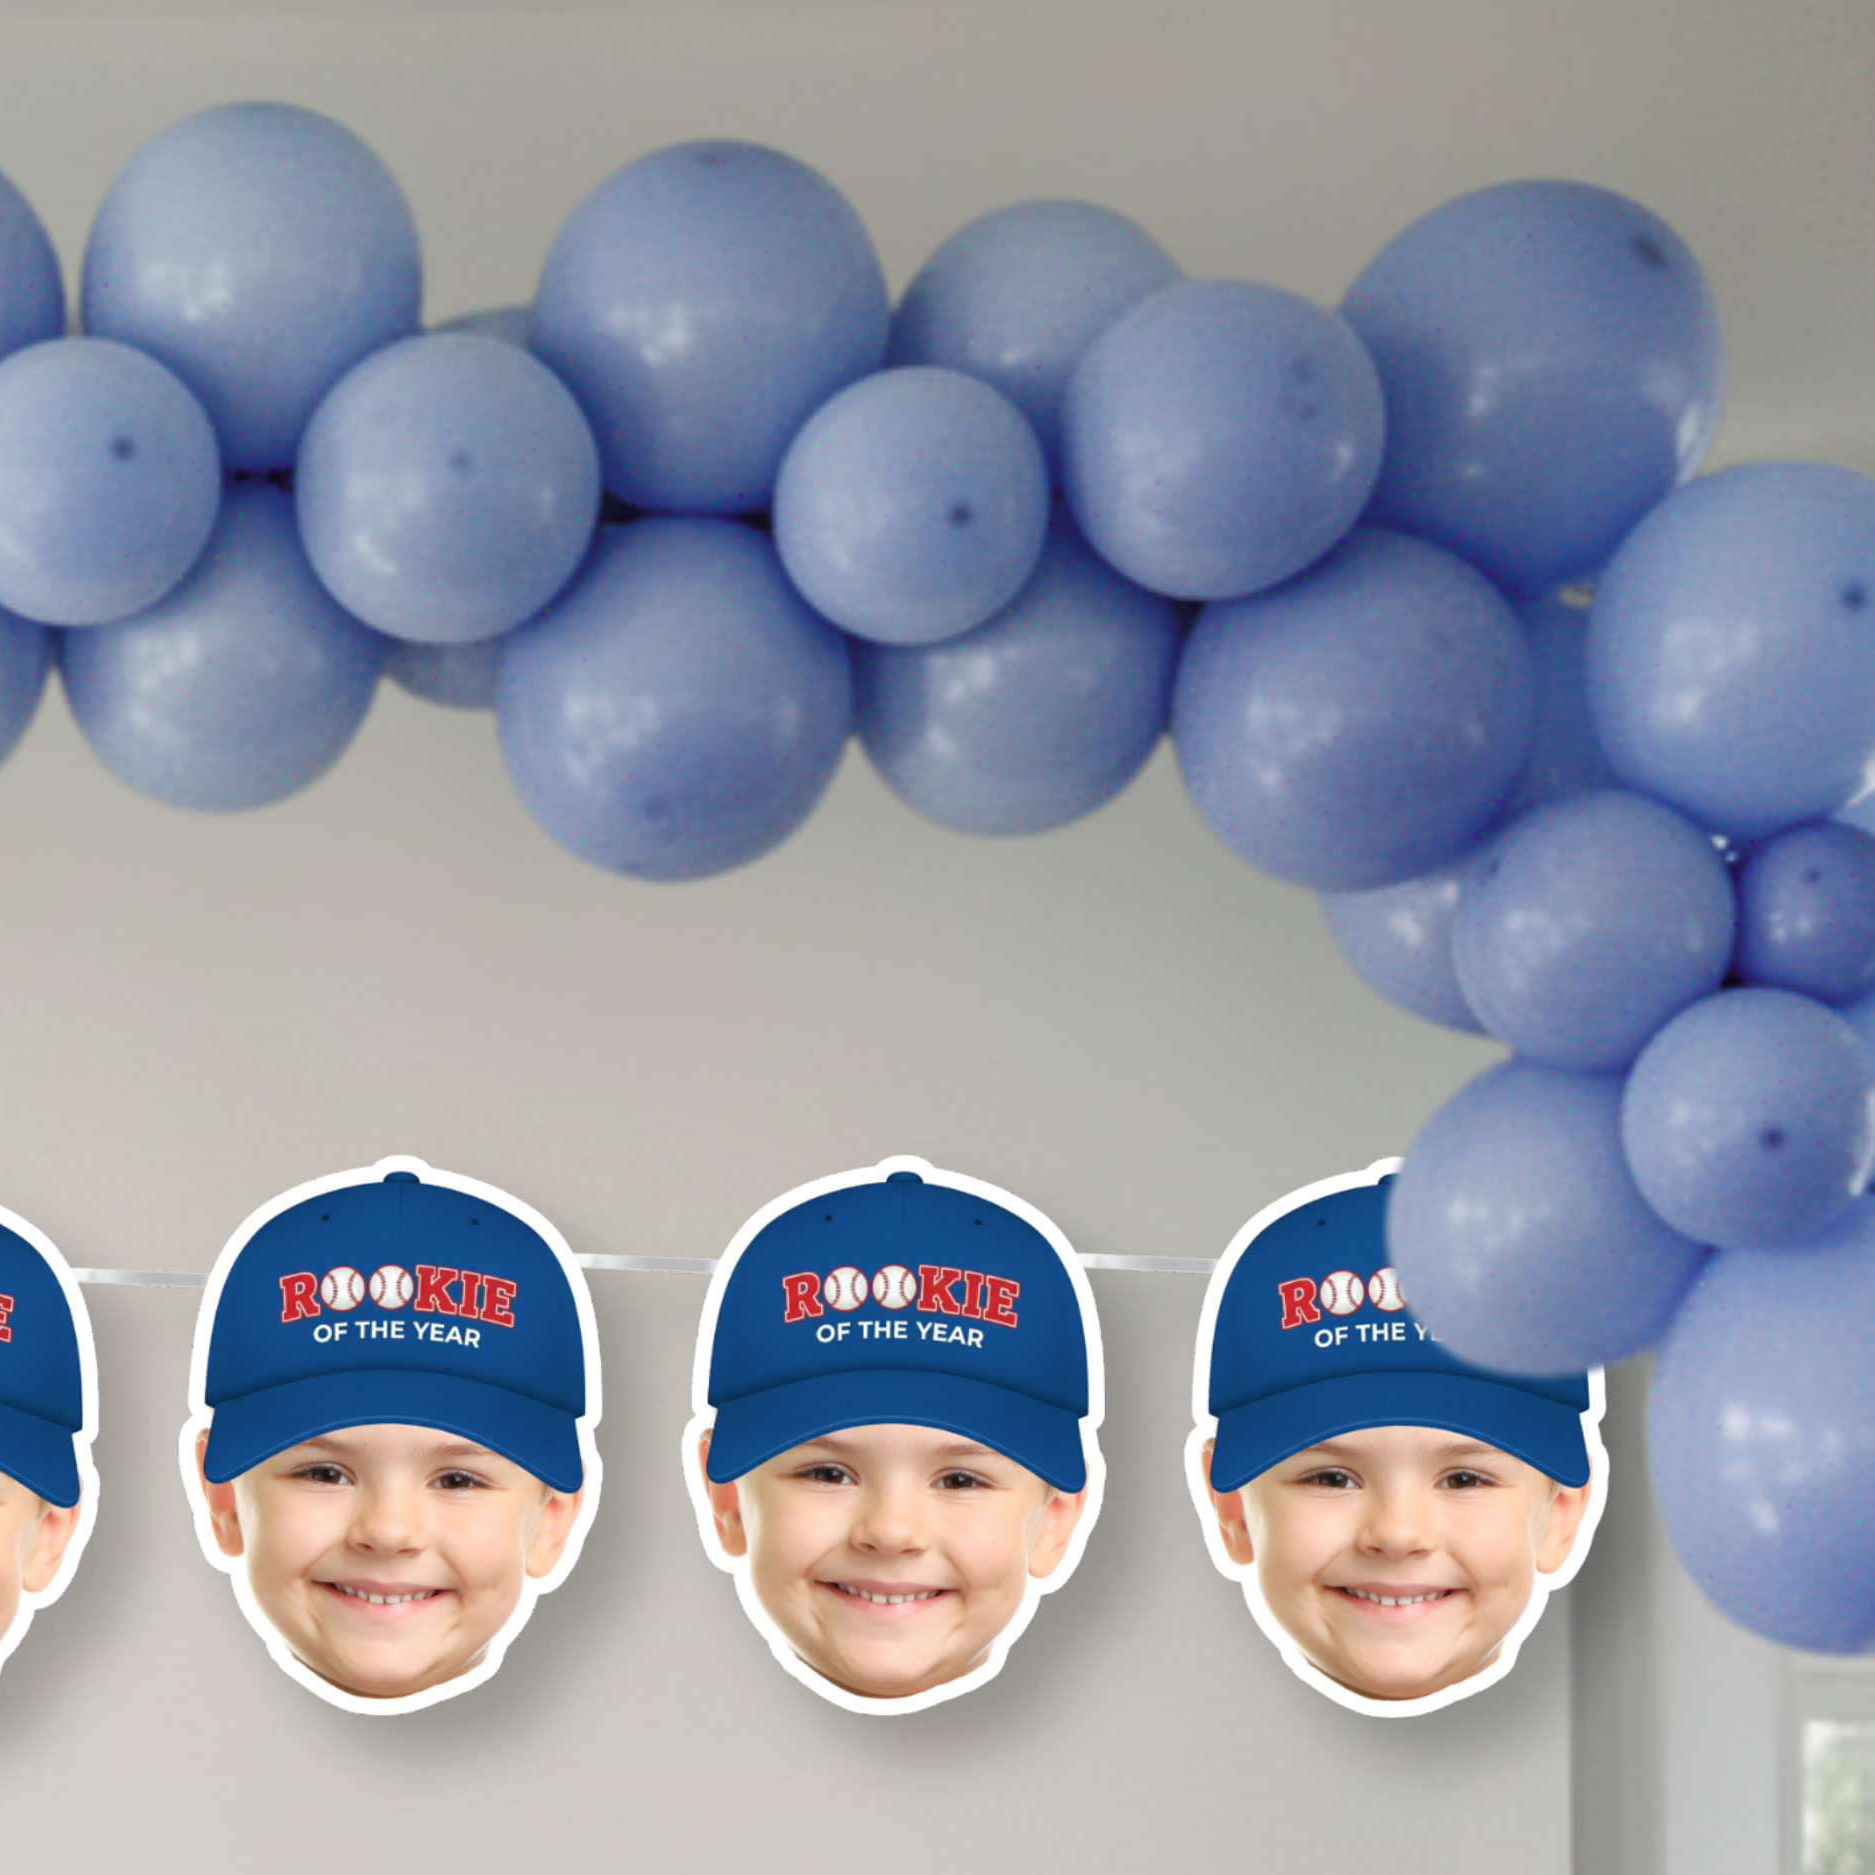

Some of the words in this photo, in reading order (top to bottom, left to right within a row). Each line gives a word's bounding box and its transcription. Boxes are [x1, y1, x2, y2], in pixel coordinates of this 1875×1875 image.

[278, 1263, 518, 1329] ROOKIE
[781, 1263, 1021, 1329] ROOKIE
[313, 1321, 348, 1343] OF
[354, 1319, 405, 1339] THE
[413, 1320, 481, 1348] YEAR
[816, 1321, 851, 1343] OF
[857, 1319, 908, 1339] THE
[916, 1320, 984, 1348] YEAR
[1312, 1327, 1347, 1349] OF
[1353, 1325, 1404, 1345] THE
